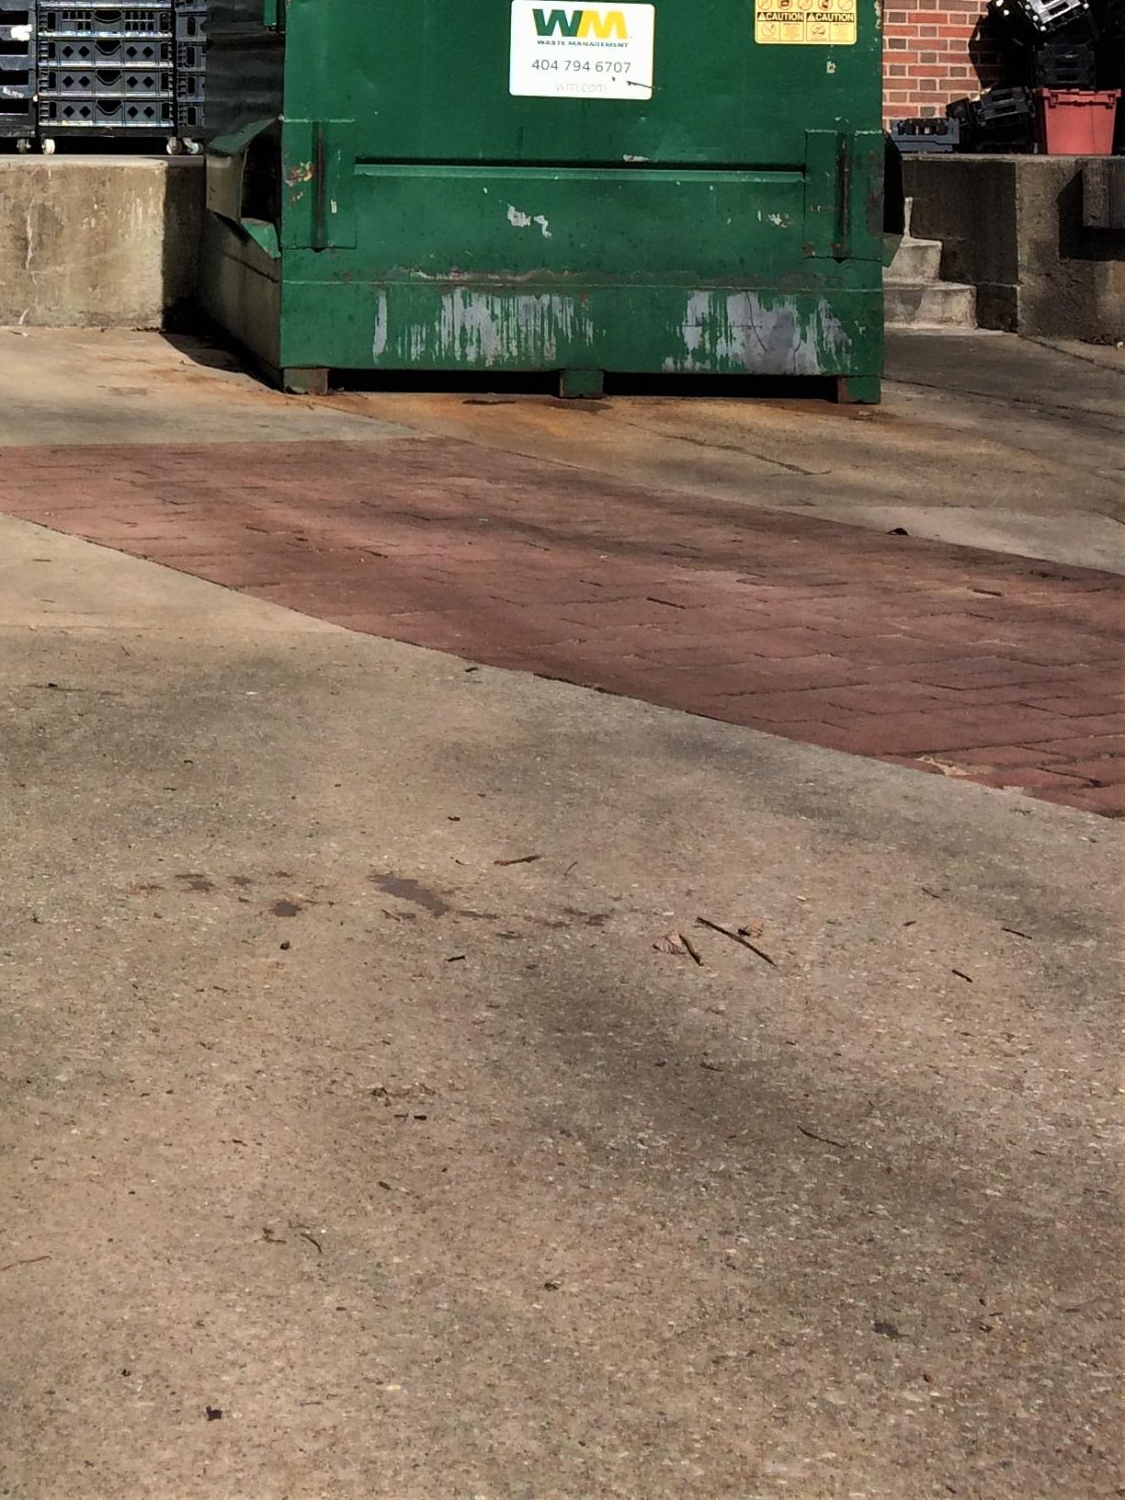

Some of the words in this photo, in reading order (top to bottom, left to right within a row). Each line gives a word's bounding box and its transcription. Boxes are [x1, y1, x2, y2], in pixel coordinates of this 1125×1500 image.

[766, 12, 804, 21] CAUTION
[816, 12, 854, 22] CAUTION
[532, 8, 629, 40] WM
[568, 40, 629, 48] MANAGEMENT
[531, 59, 558, 71] 404
[564, 60, 591, 72] 794
[595, 61, 631, 74] 6707
